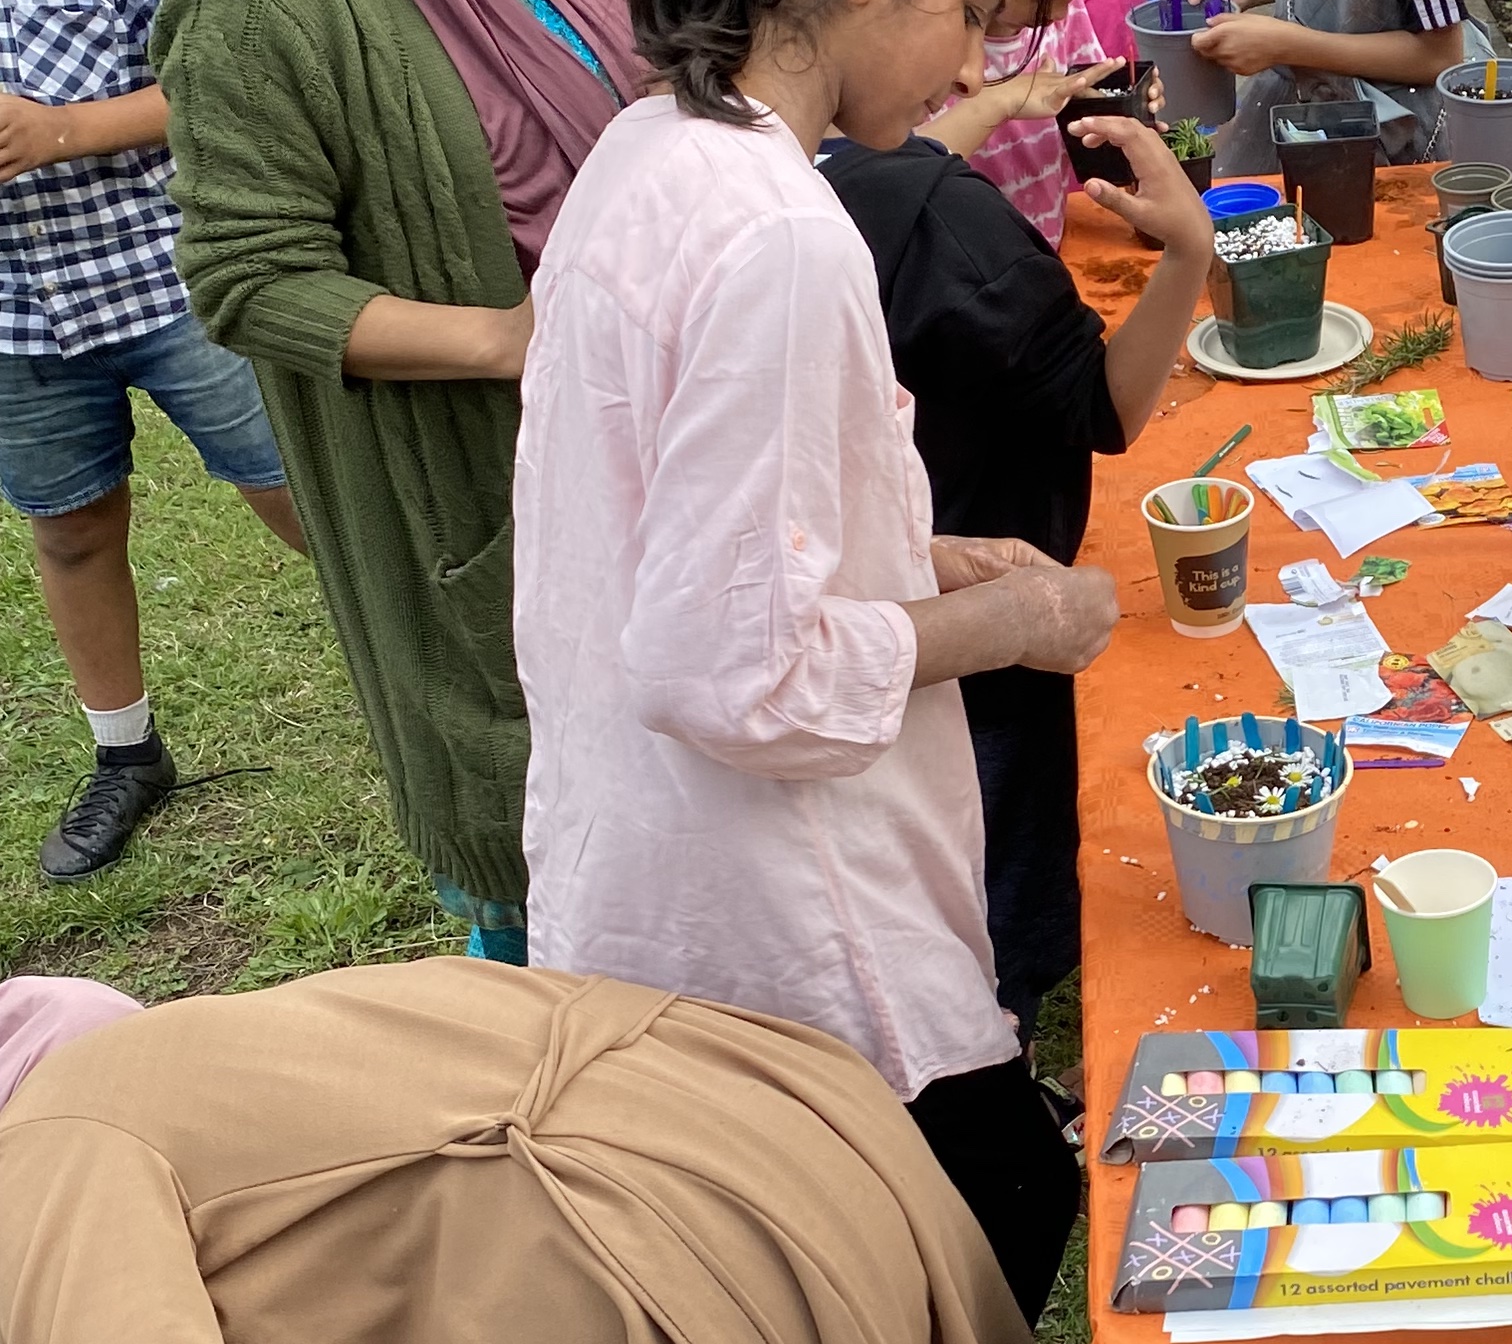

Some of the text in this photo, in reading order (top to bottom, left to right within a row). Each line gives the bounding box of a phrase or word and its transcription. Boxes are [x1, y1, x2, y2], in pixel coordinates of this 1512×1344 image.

[1192, 570, 1219, 582] This
[1222, 568, 1230, 577] is
[1280, 1284, 1302, 1297] 12
[1306, 1279, 1378, 1294] assorted
[1384, 1277, 1470, 1293] pavement
